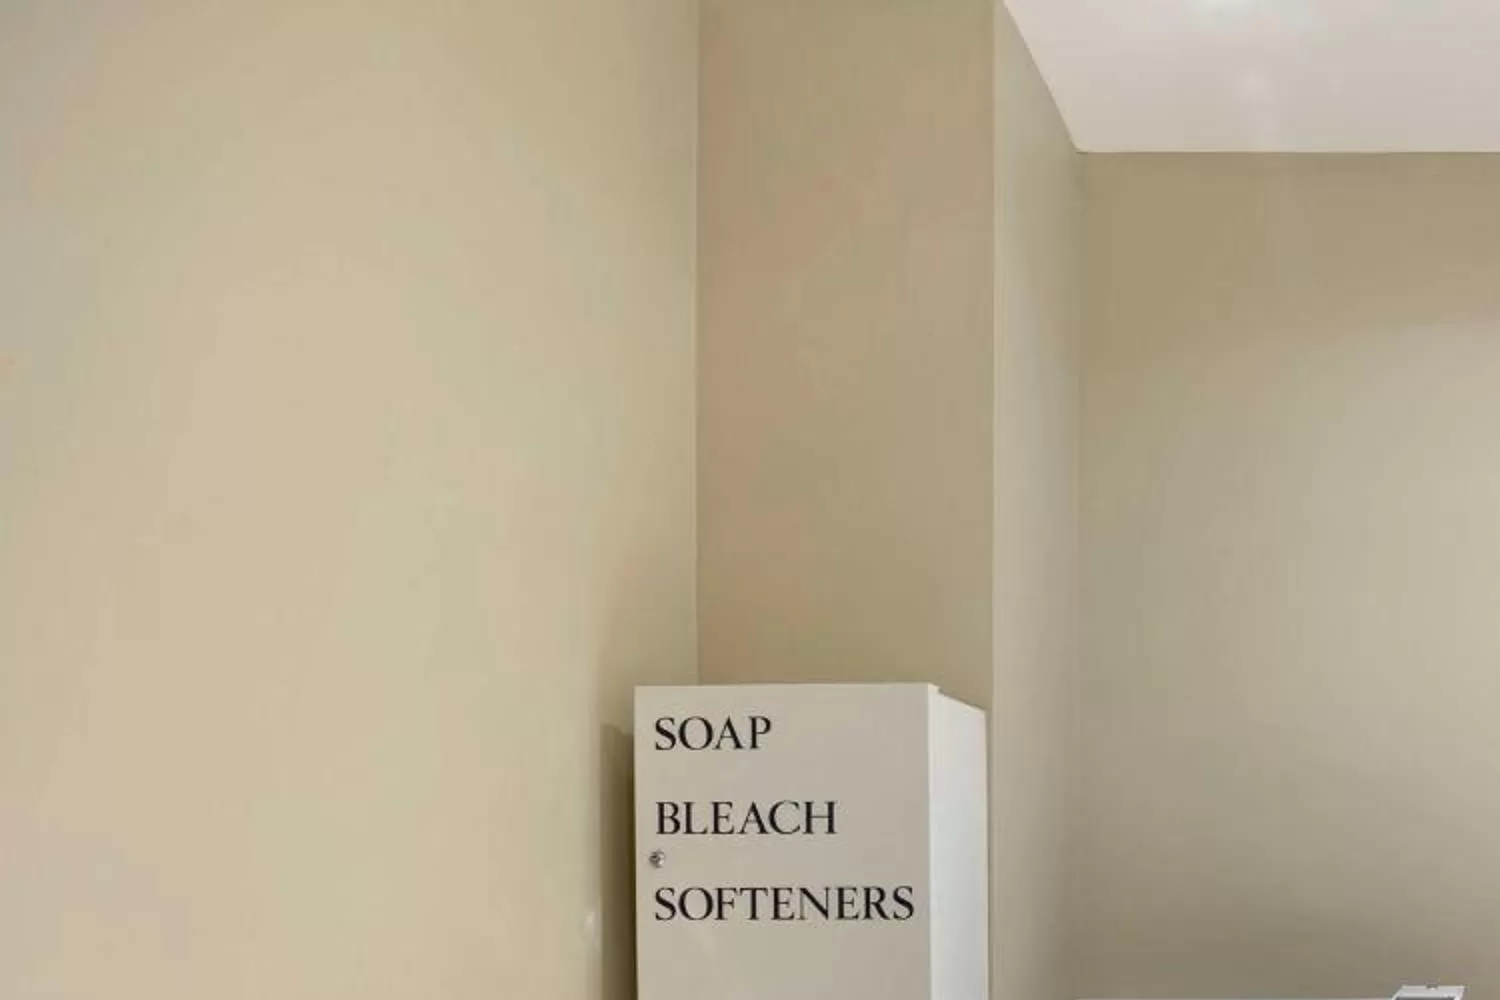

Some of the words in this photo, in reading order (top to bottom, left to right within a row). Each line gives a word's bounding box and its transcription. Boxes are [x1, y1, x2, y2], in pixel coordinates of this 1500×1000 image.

[655, 716, 772, 751] SOAP
[655, 800, 839, 835] BLEACH
[654, 885, 915, 921] SOFTENERS
